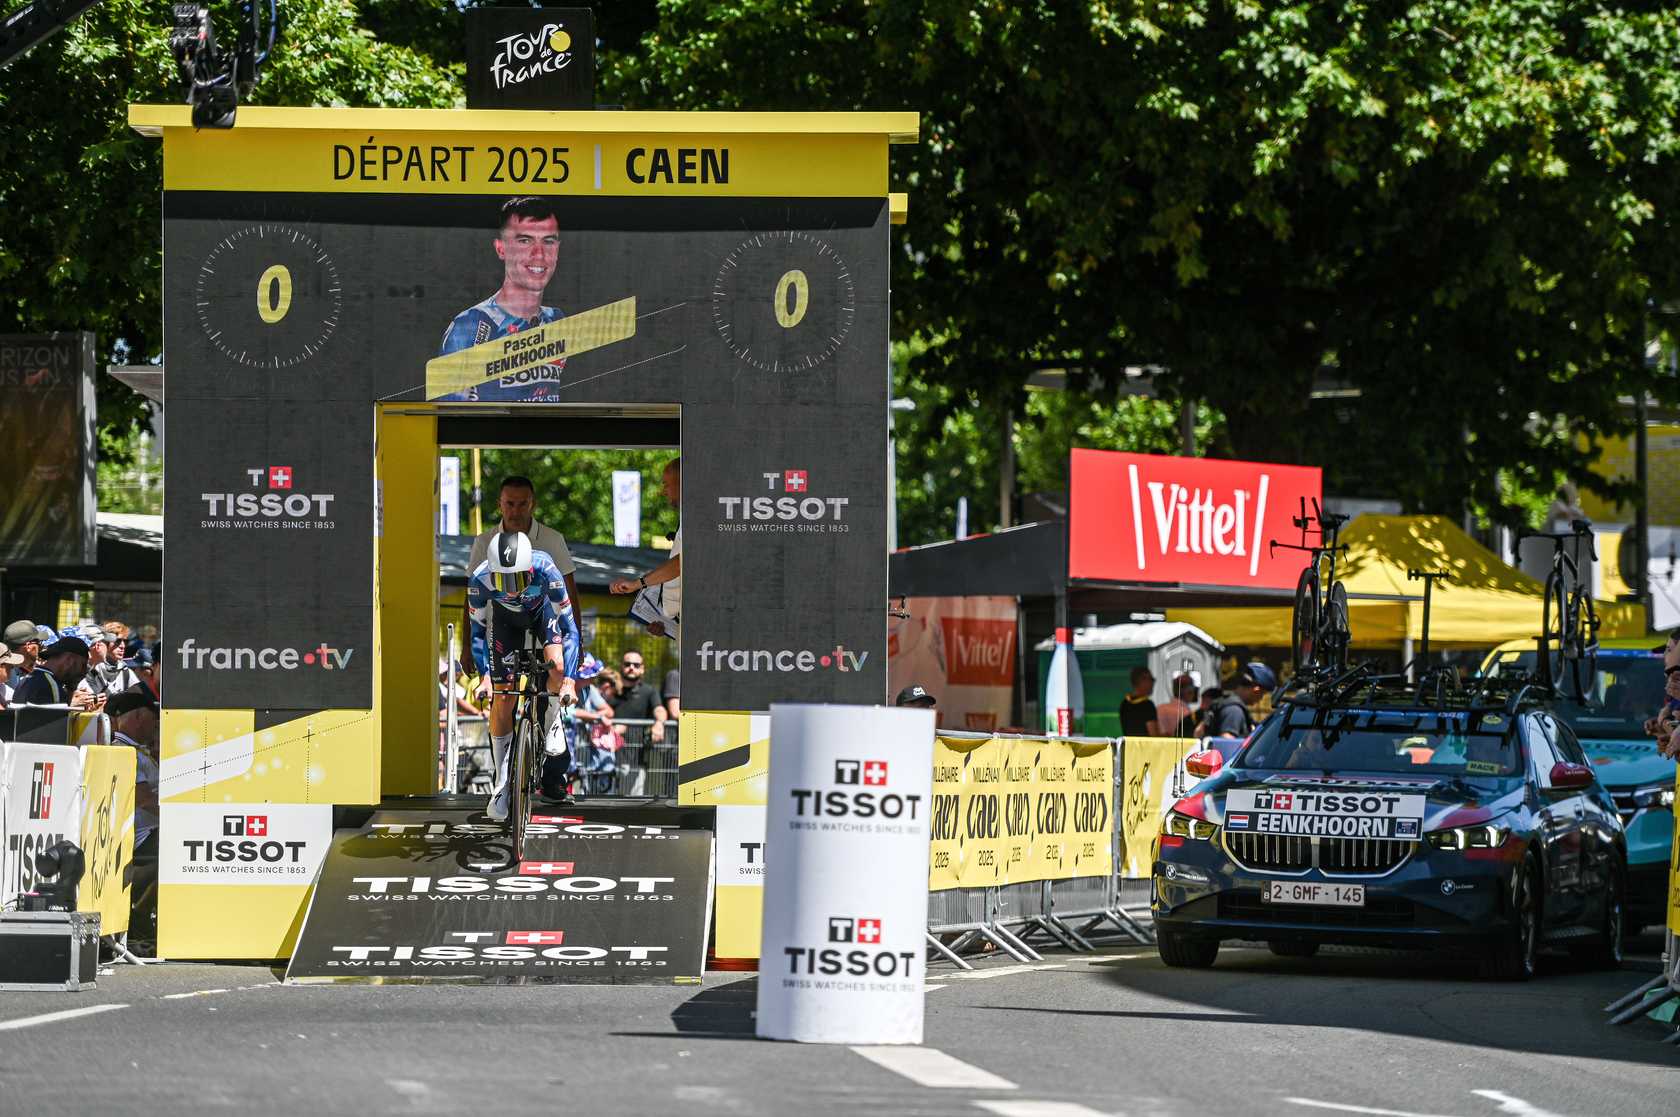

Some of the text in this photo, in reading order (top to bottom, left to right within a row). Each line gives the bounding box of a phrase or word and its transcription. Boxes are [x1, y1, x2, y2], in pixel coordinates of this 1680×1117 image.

[333, 135, 729, 184] DÉPART 2025 CAEN
[256, 264, 293, 324] 0
[774, 269, 809, 328] 0
[503, 328, 545, 355] Pascal
[486, 338, 566, 377] EENKHOORN
[201, 493, 335, 517] TISSOT
[718, 496, 849, 520] TISSOT
[201, 521, 335, 529] SWISS WATCHES SINCE 1853
[718, 524, 849, 533] SWISS WATCHES SINCE 1853
[1147, 482, 1247, 556] Vittel
[791, 790, 922, 820] TISSOT
[1296, 795, 1400, 814] TISSOT
[821, 822, 873, 833] WATCHES
[1257, 813, 1389, 837] EENKHOORN
[183, 840, 306, 863] TISSOT
[212, 866, 255, 874] WATCHES
[257, 866, 284, 874] SINCE
[352, 876, 675, 893] TISSOT
[332, 946, 668, 960] TISSOT
[784, 947, 915, 977] TISSOT
